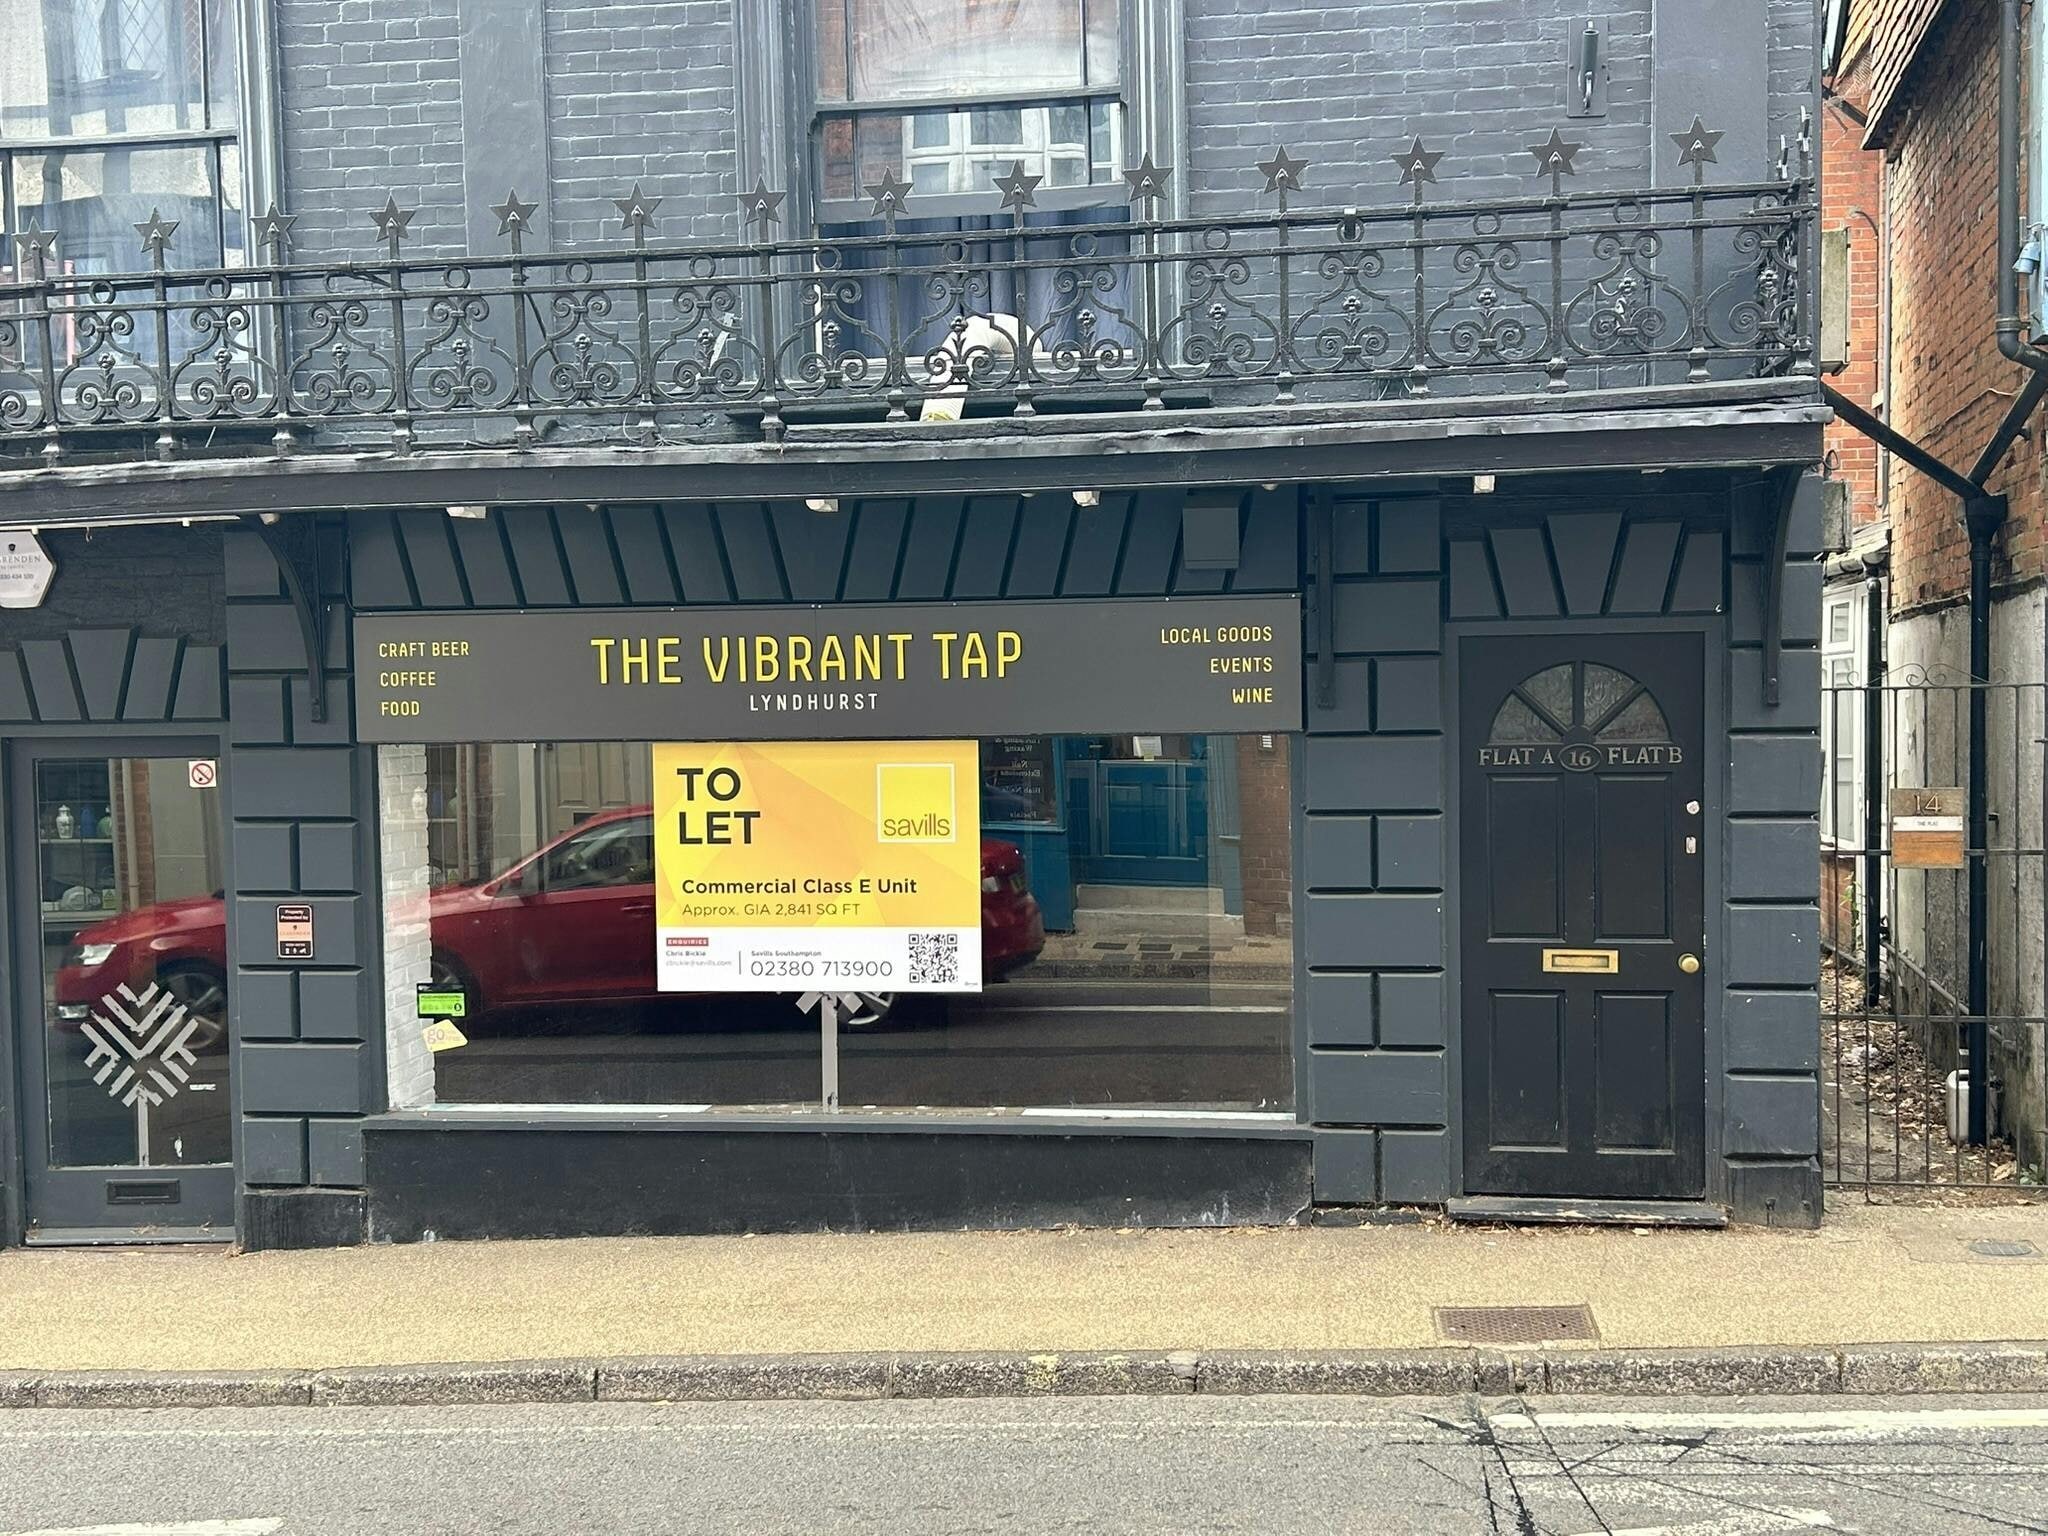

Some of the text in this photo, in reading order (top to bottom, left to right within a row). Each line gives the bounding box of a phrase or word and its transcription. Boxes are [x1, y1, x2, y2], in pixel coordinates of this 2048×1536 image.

[1161, 626, 1273, 644] LOCAL GOODS
[379, 641, 470, 658] CRAFT BEER
[590, 631, 1023, 685] THE VIBRANT TAP
[1210, 657, 1273, 674] EVENTS
[379, 671, 437, 687] COFFEE
[749, 693, 879, 712] LYNDHURST
[1232, 687, 1273, 703] WINE
[381, 701, 420, 717] FOOD
[1479, 748, 1554, 766] FLAT A
[1568, 751, 1592, 766] 16
[1608, 746, 1683, 764] FLAT B
[677, 767, 742, 801] TO
[1913, 792, 1942, 814] 14
[679, 811, 761, 845] LET
[883, 813, 951, 838] savills
[681, 878, 918, 895] Commercial Class E Unit
[682, 903, 861, 918] Approx. GIA 2,841 SQ FT
[667, 937, 708, 946] ENQUIRIES
[751, 960, 893, 977] 02380 713900
